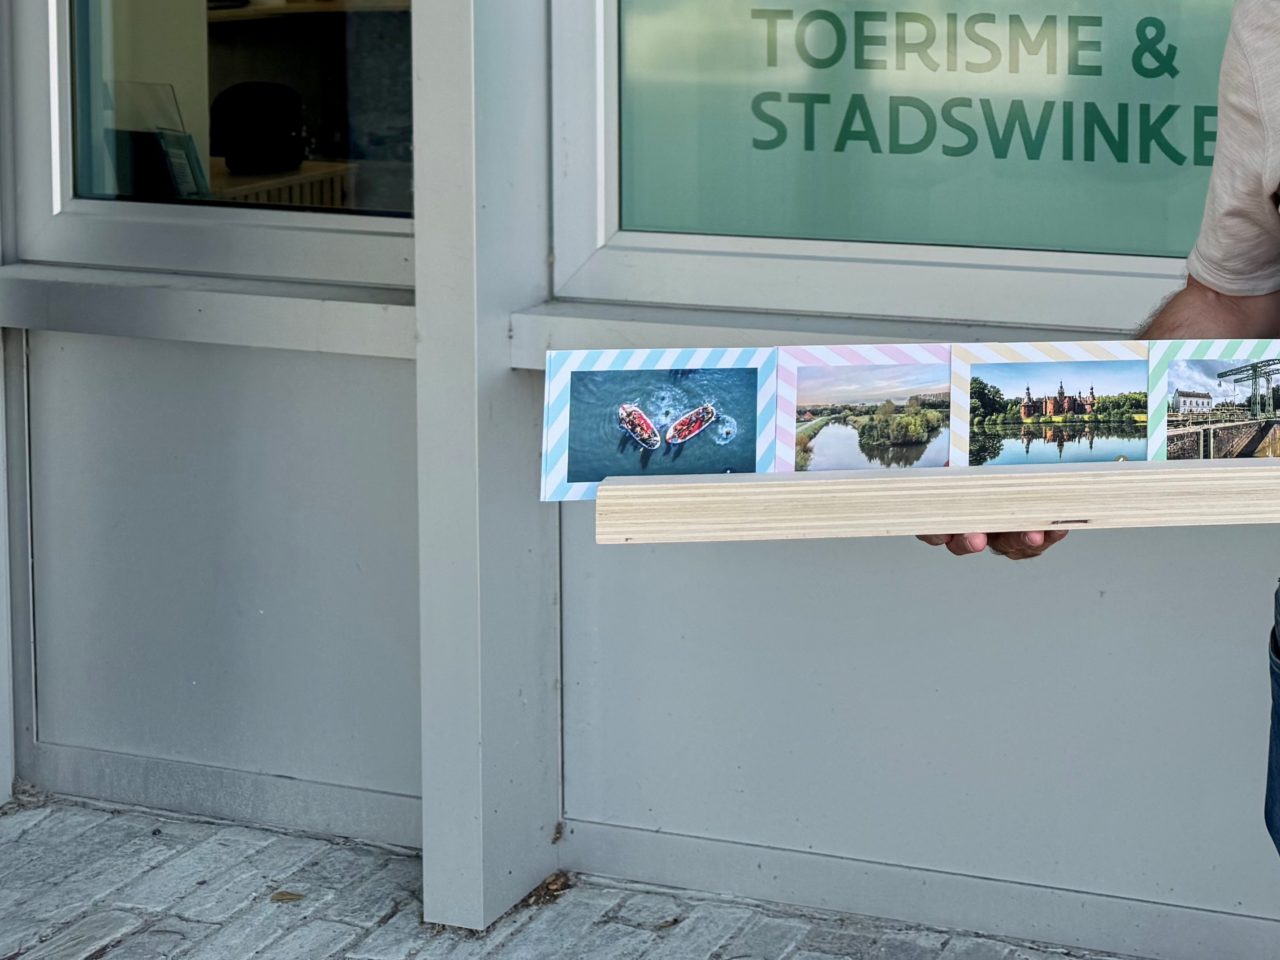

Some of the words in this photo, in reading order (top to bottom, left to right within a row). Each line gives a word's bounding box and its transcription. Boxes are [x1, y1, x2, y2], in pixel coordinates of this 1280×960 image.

[750, 8, 1103, 77] TOERISME
[1131, 16, 1180, 80] &
[750, 91, 1219, 167] STADSWINKE
